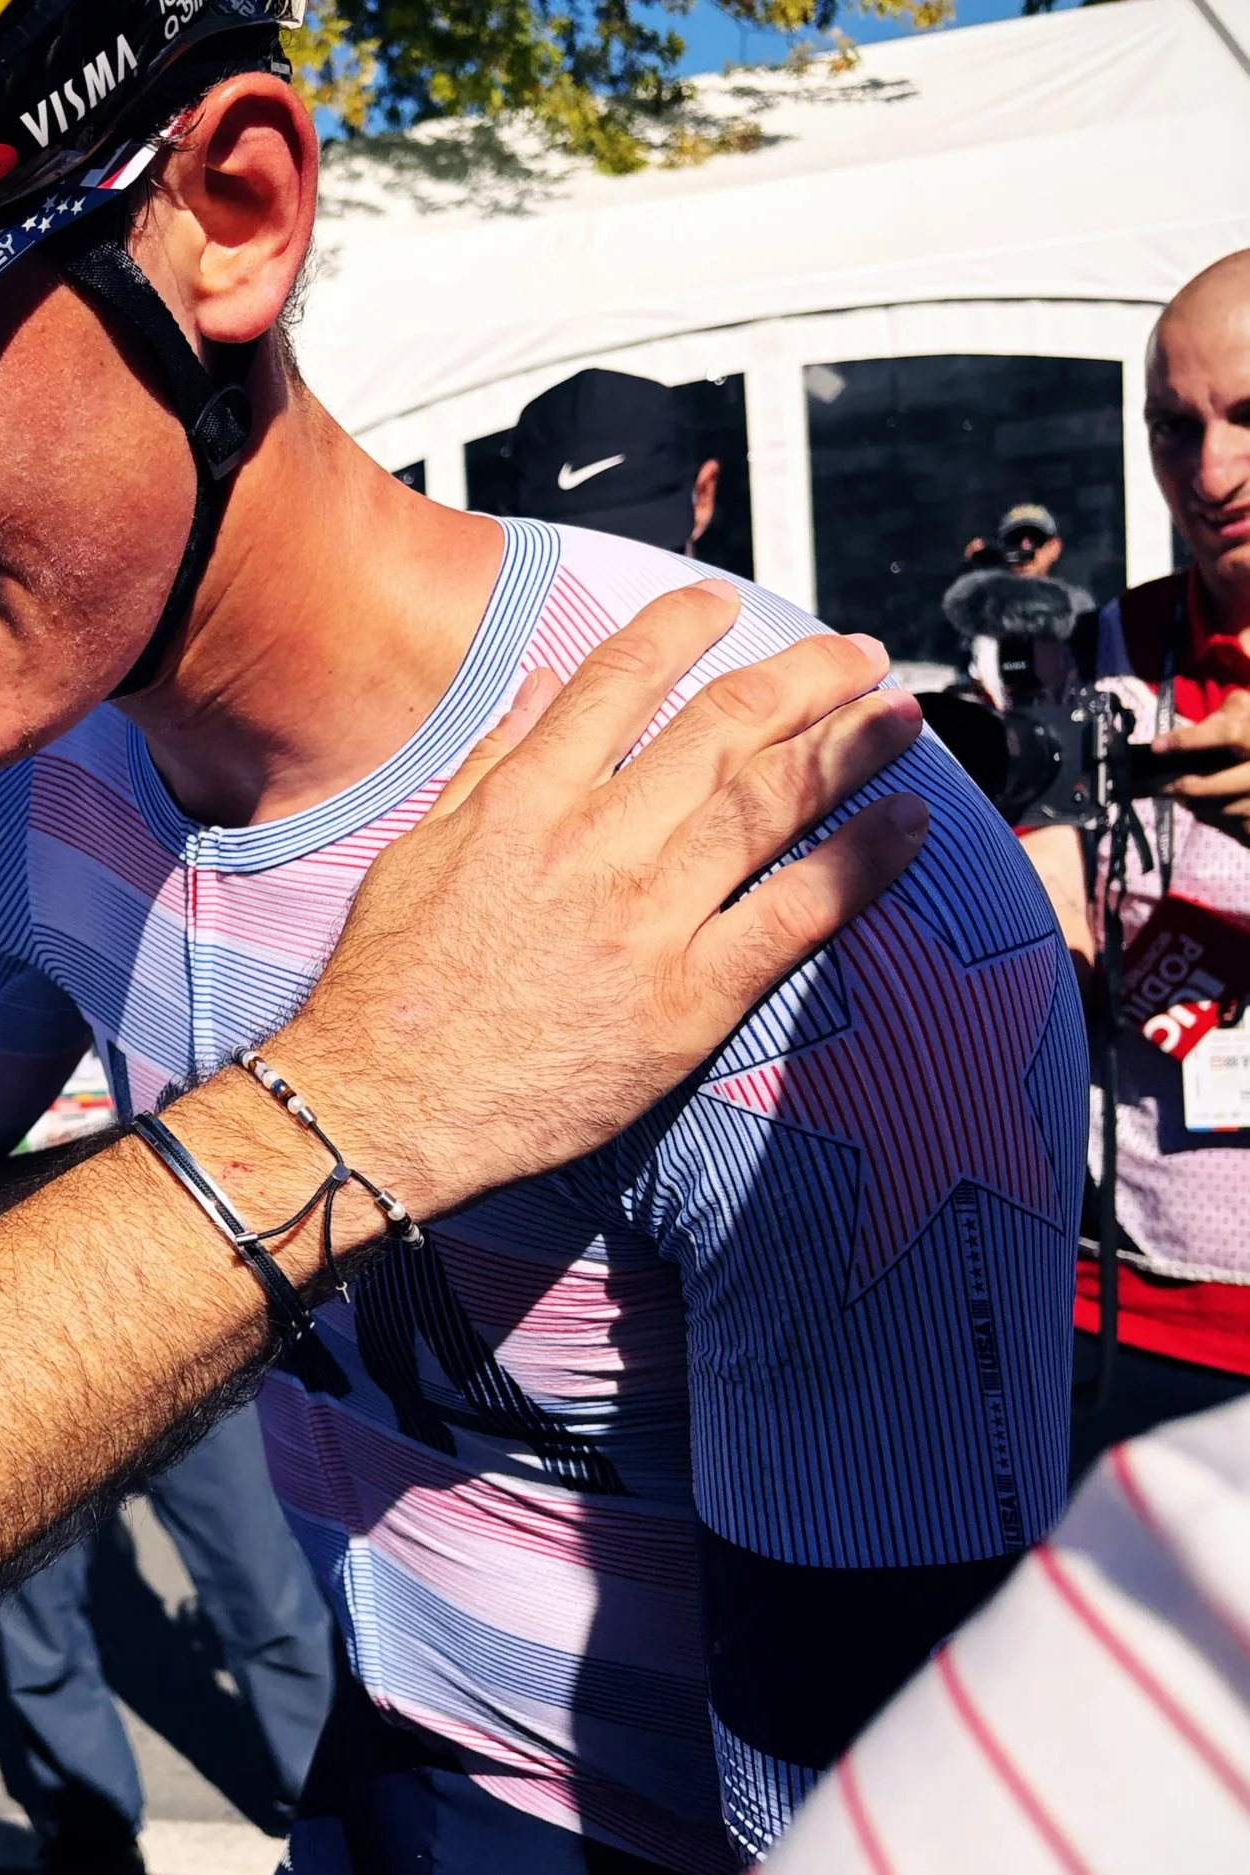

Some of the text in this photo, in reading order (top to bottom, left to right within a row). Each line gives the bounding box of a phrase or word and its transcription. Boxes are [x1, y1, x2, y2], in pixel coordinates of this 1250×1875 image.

[19, 33, 138, 148] VISMA
[977, 1319, 998, 1371] USA
[1000, 1494, 1021, 1545] USA
